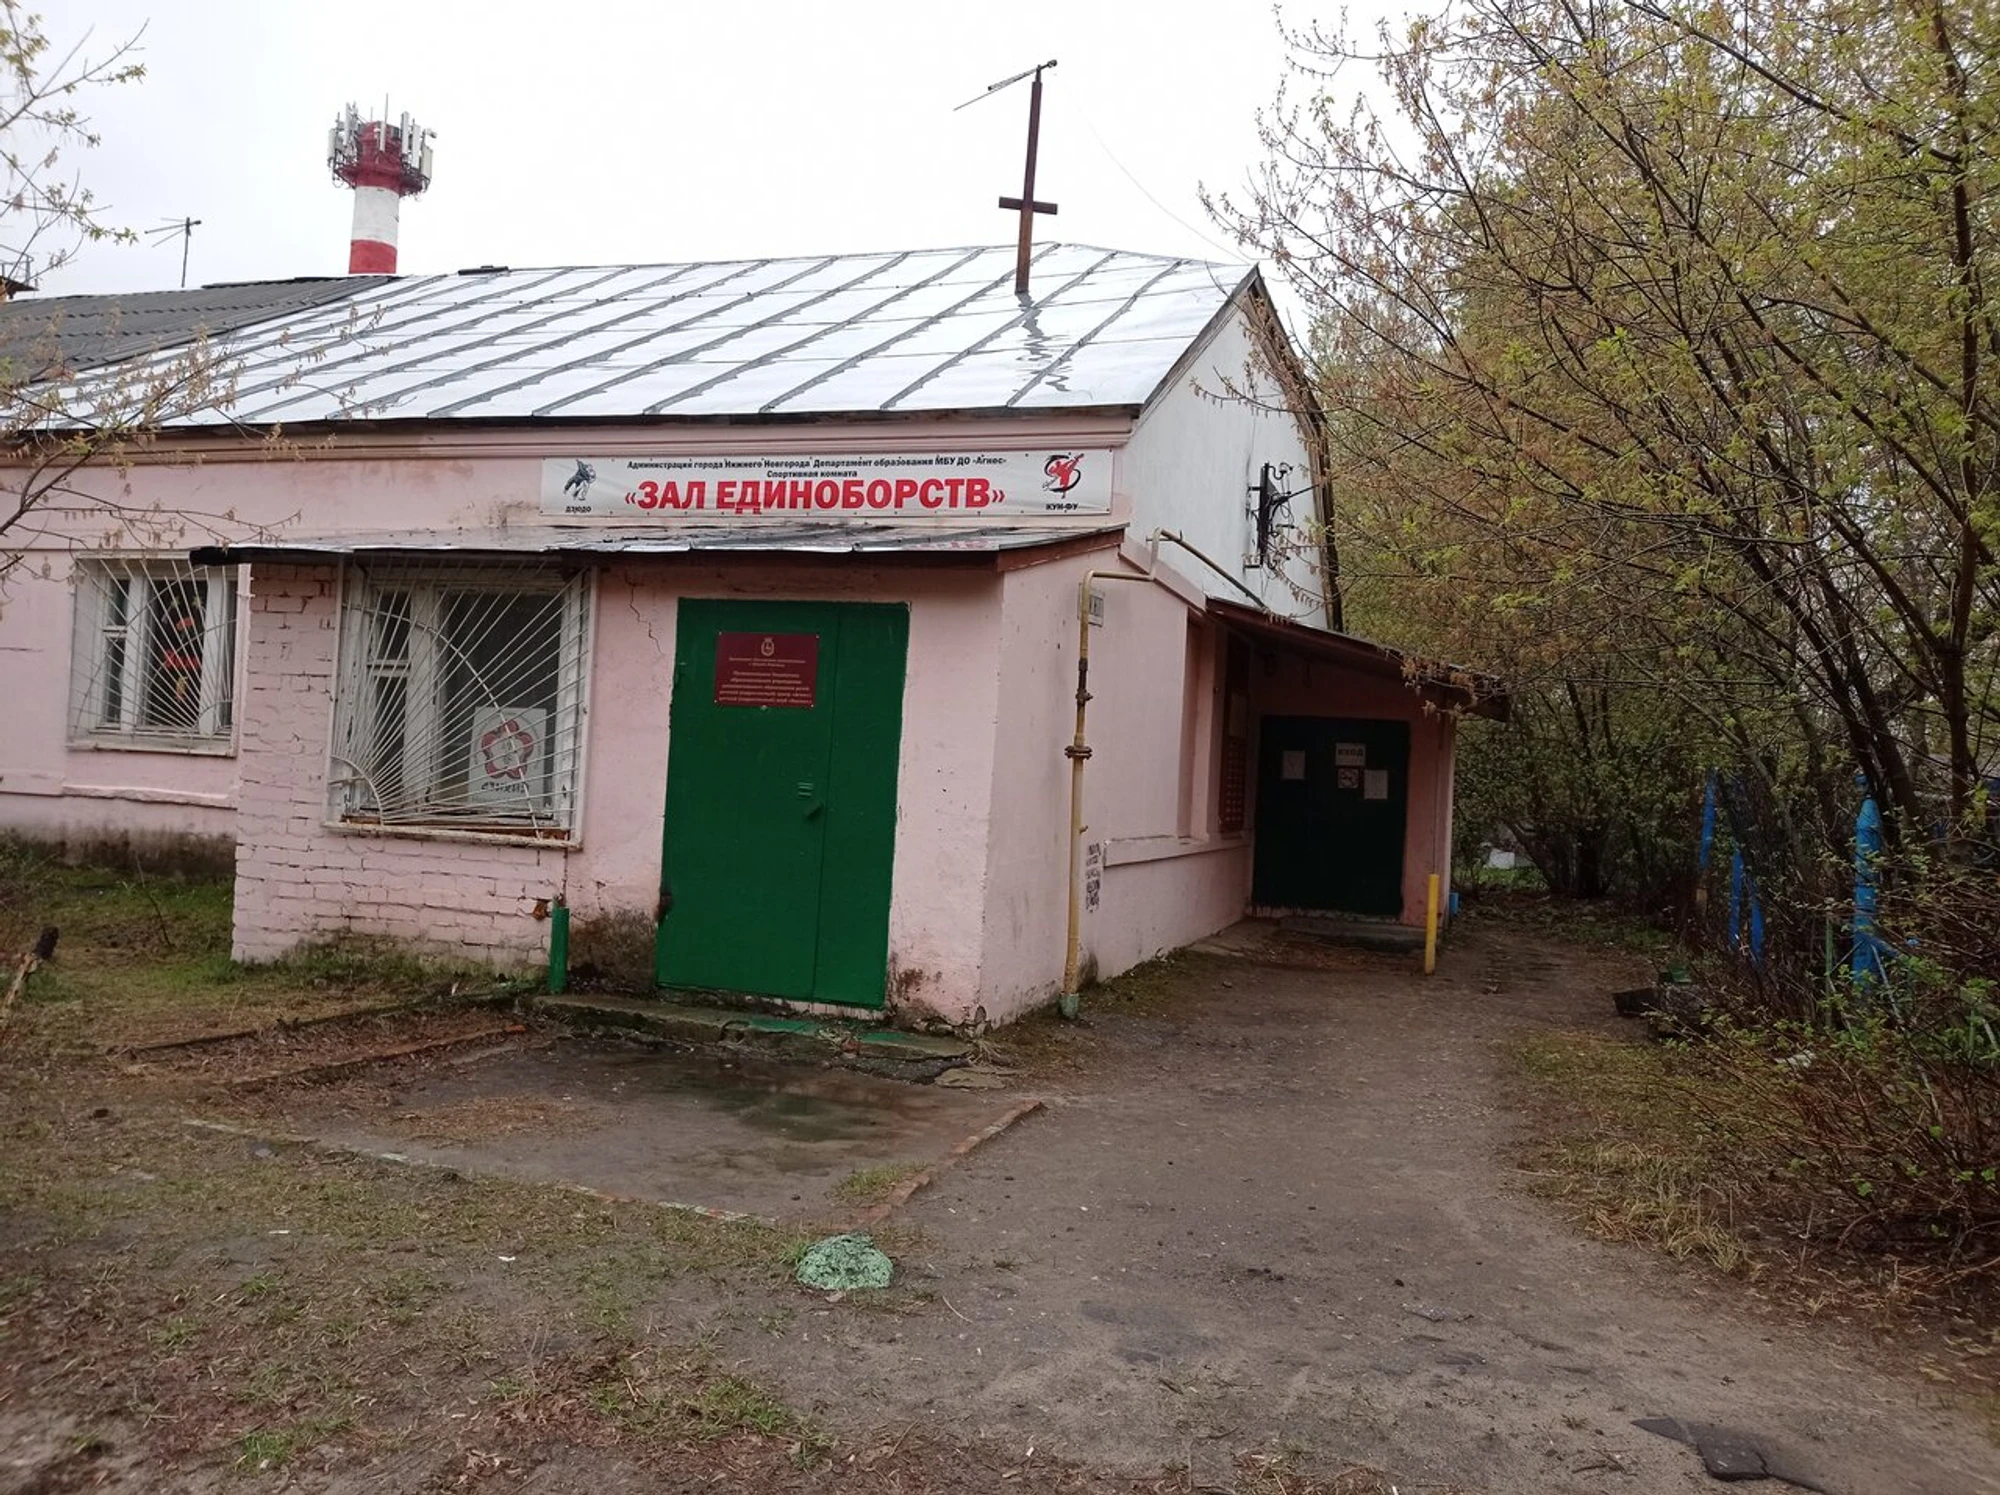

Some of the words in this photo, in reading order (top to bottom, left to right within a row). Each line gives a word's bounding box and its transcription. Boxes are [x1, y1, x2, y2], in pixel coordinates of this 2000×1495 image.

[627, 461, 692, 470] Администрация
[693, 461, 722, 469] города
[724, 460, 762, 468] Нижнего
[764, 459, 810, 468] Новгорода
[813, 459, 873, 468] Департамент
[873, 458, 934, 468] образования
[935, 456, 955, 466] МБУ
[957, 456, 971, 466] ДО
[766, 470, 819, 479] Спортивная
[820, 470, 858, 478] комната
[625, 481, 706, 509] «ЗАЛ
[716, 478, 1006, 514] ЕДИНОБОРСТВ»
